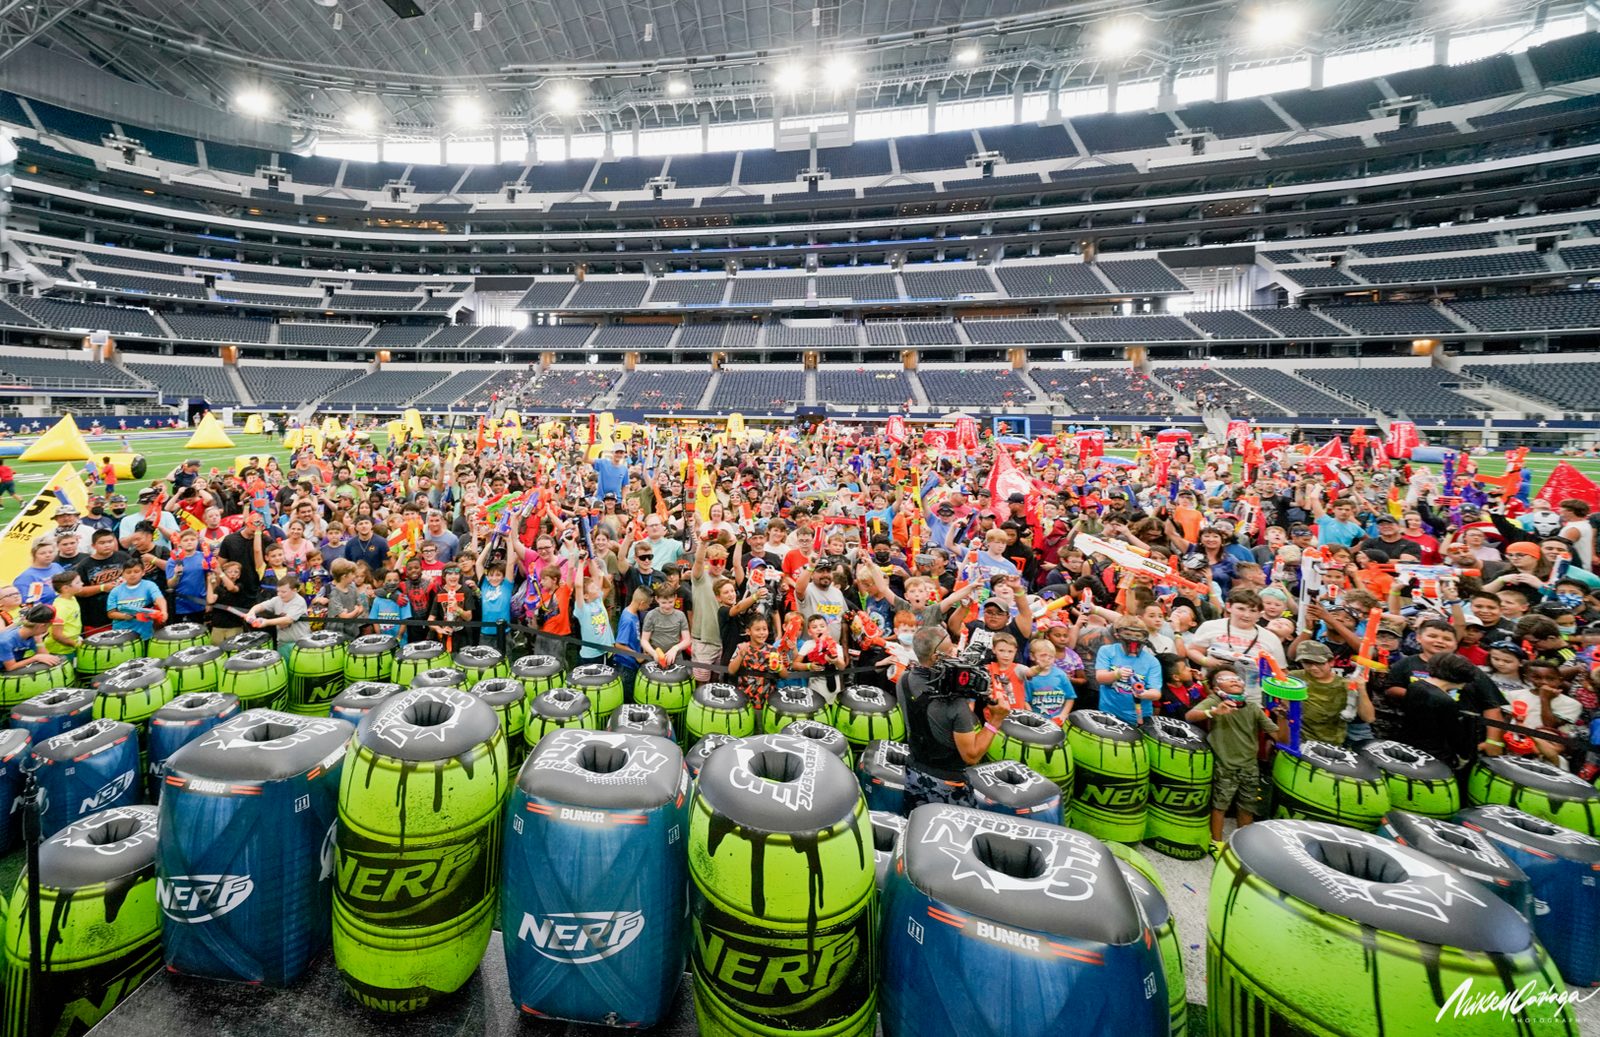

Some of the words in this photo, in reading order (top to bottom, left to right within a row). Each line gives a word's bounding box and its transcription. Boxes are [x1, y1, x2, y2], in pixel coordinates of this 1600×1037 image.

[188, 778, 227, 794] BUNKR
[560, 808, 605, 824] BUNKR
[1033, 826, 1093, 848] EPIC
[1155, 841, 1202, 859] BUNKR
[335, 838, 481, 903] NERF
[156, 874, 254, 918] NERF
[518, 909, 645, 956] NERF
[976, 920, 1042, 951] BUNKR
[692, 914, 859, 999] NERF
